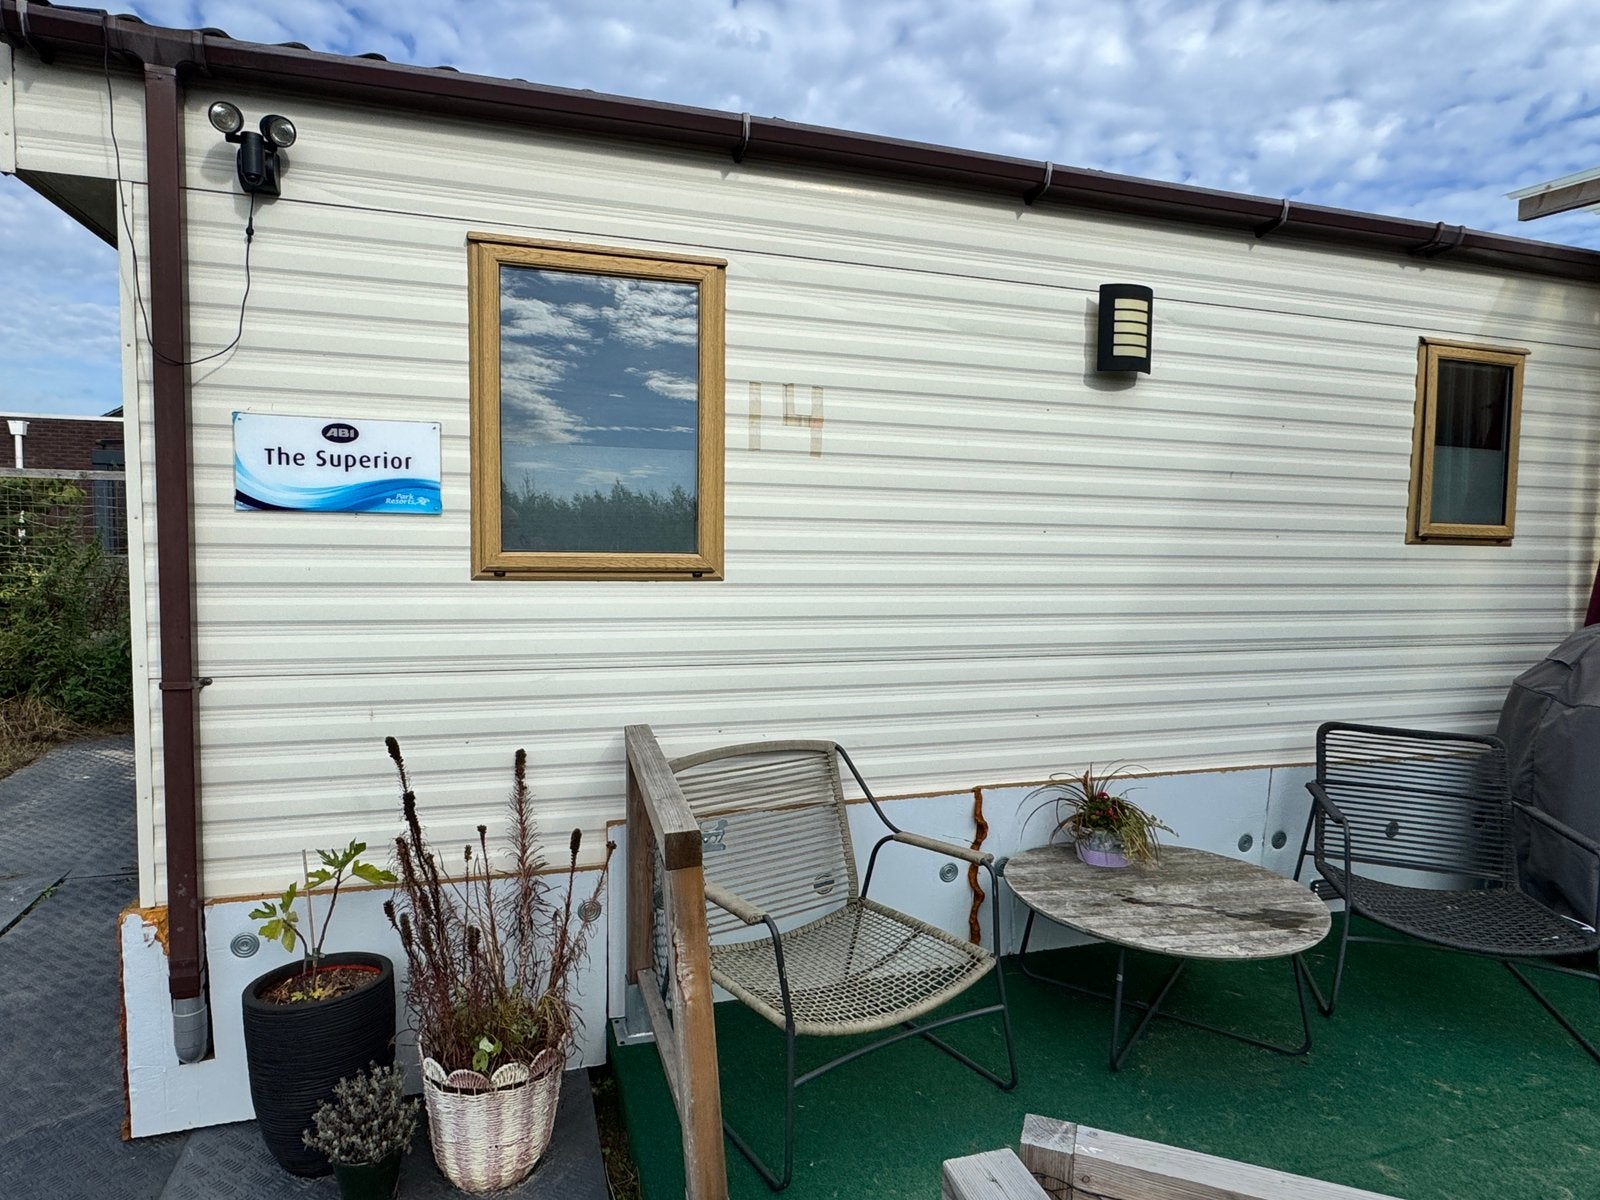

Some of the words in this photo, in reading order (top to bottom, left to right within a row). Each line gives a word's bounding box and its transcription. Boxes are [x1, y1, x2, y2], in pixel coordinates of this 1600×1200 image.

[748, 381, 824, 457] 14
[326, 428, 355, 438] ABI
[264, 447, 306, 466] The
[316, 450, 412, 472] Superior
